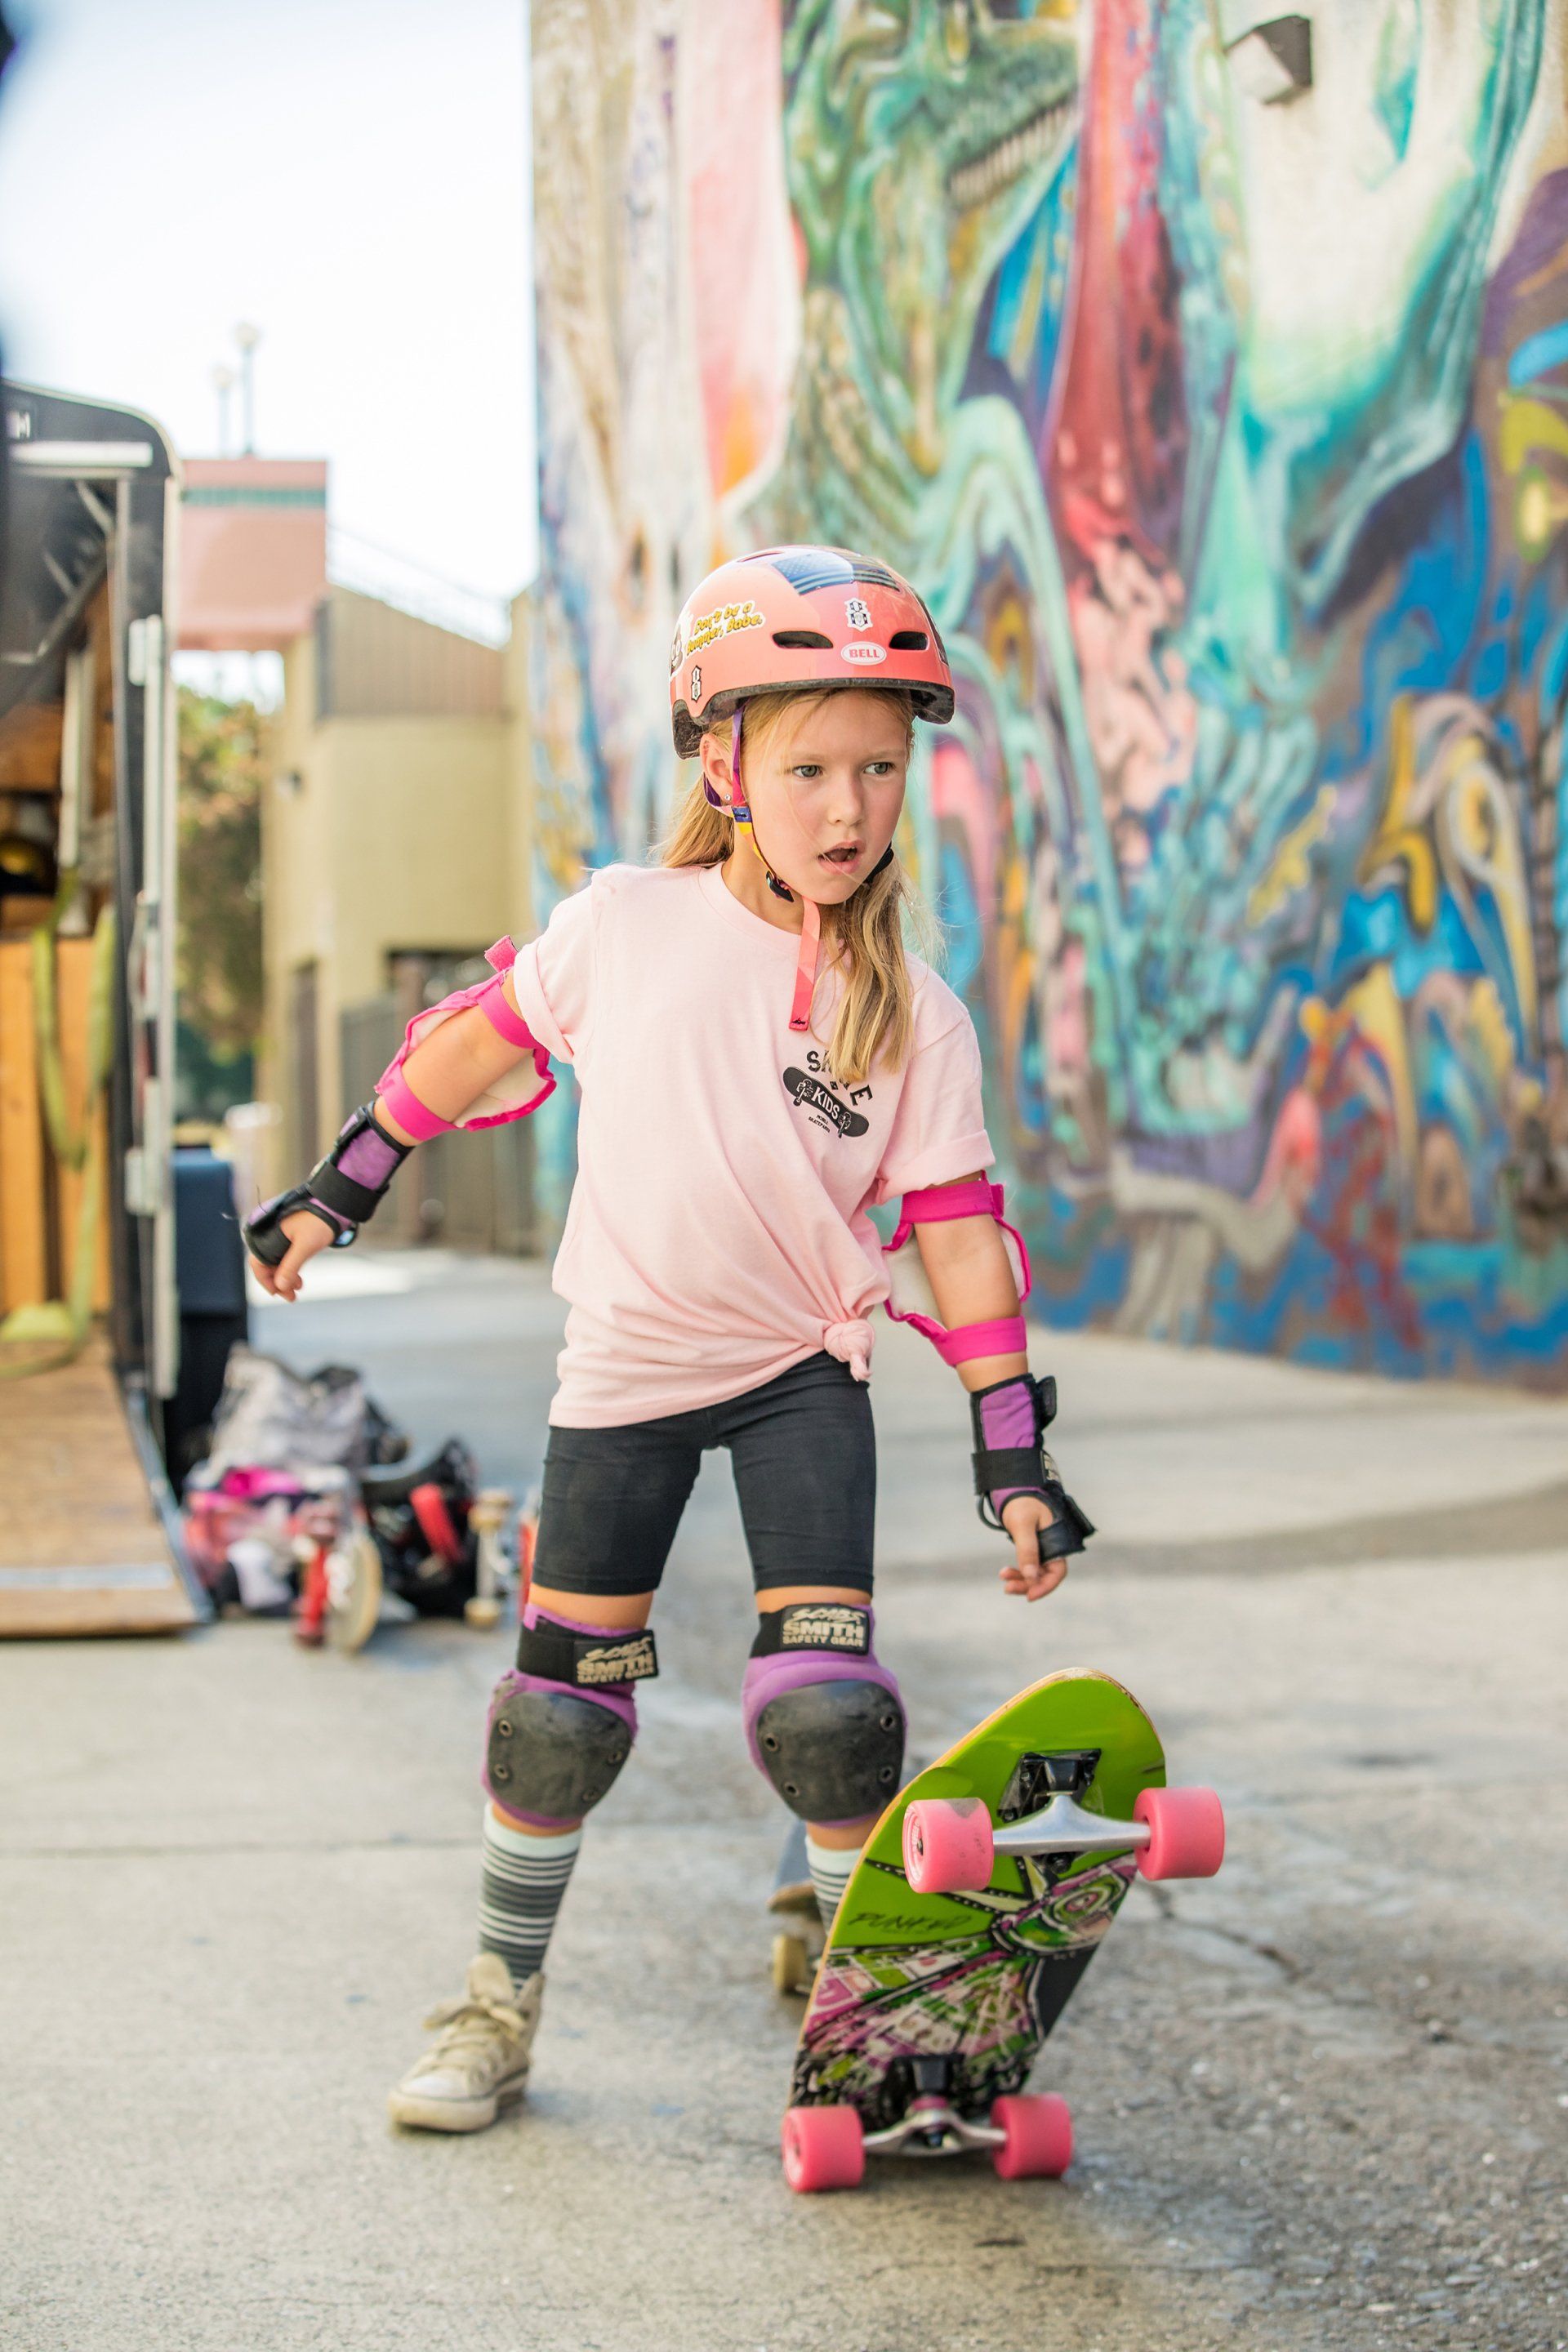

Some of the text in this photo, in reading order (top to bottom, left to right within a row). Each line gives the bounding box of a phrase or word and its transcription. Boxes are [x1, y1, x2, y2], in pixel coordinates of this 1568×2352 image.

[694, 611, 722, 635] Don't
[724, 605, 740, 620] be
[849, 648, 880, 658] BELL
[811, 1086, 840, 1120] KIDS
[783, 1619, 864, 1638] SMITH
[782, 1635, 863, 1646] SAFETY GEAR
